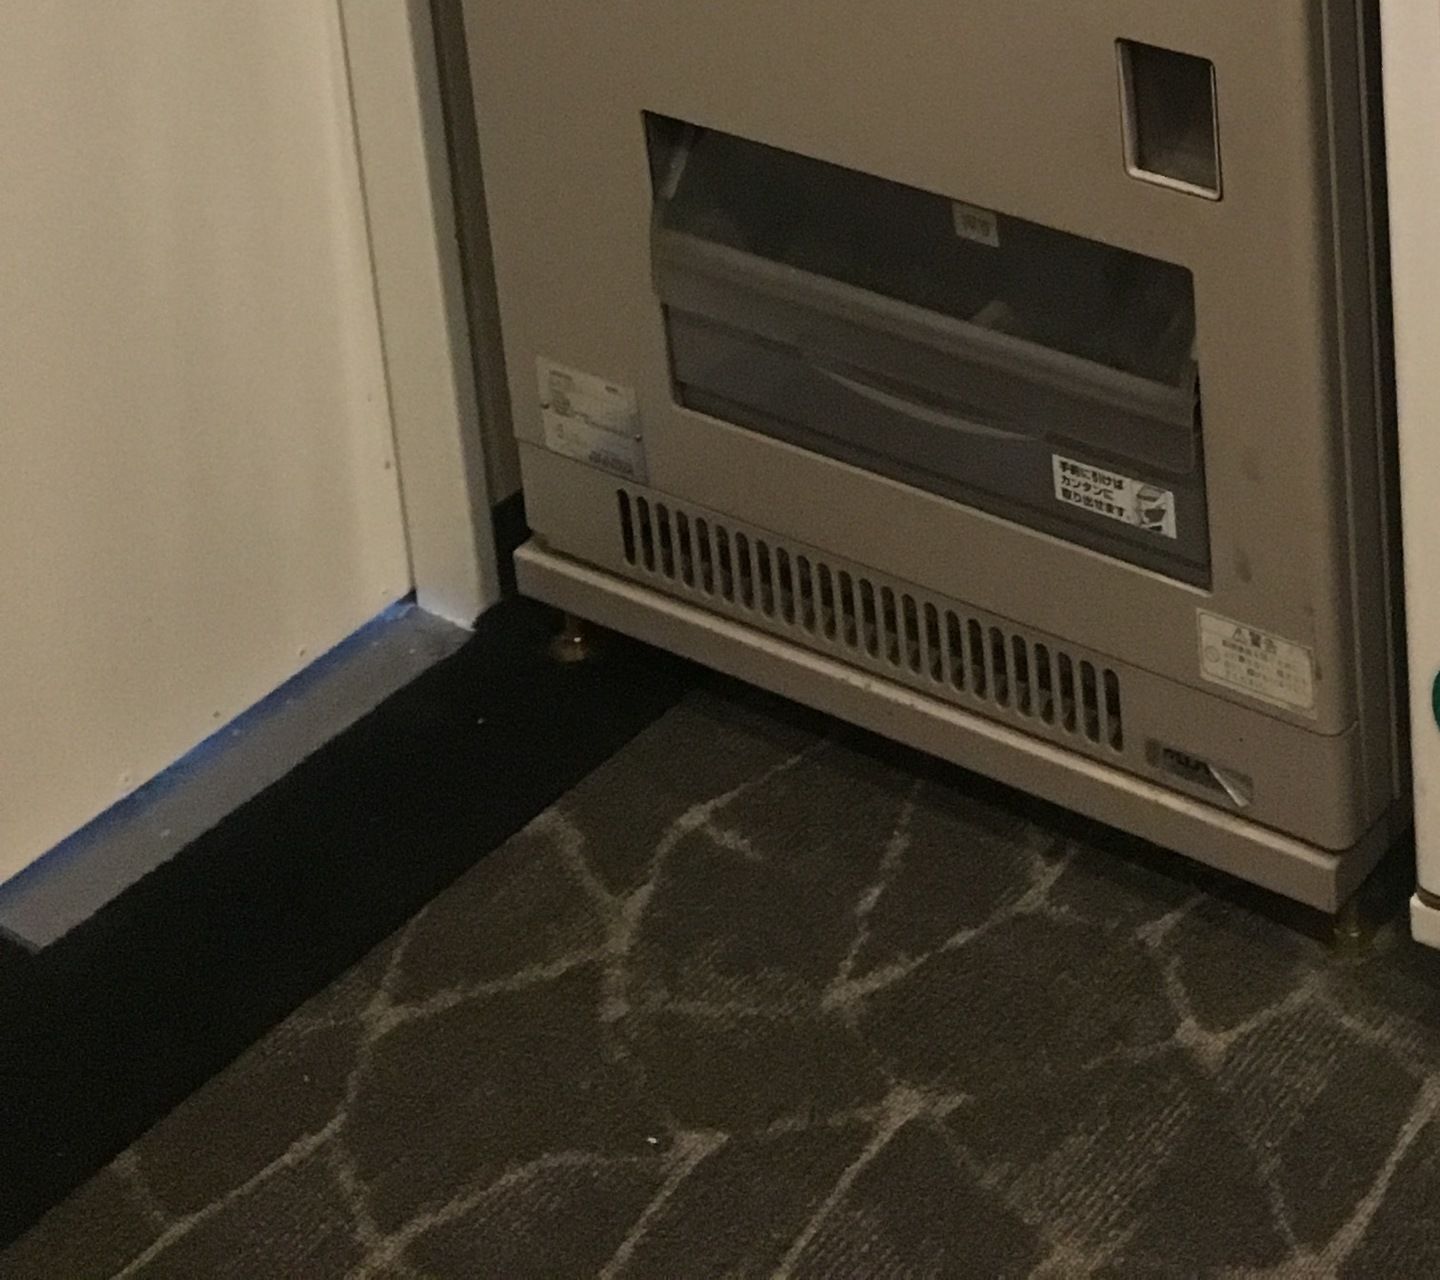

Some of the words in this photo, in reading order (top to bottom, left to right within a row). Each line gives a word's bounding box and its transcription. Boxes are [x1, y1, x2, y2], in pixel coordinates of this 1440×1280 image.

[1059, 460, 1124, 491] 手前に引けば
[1061, 475, 1114, 502] カンタンに
